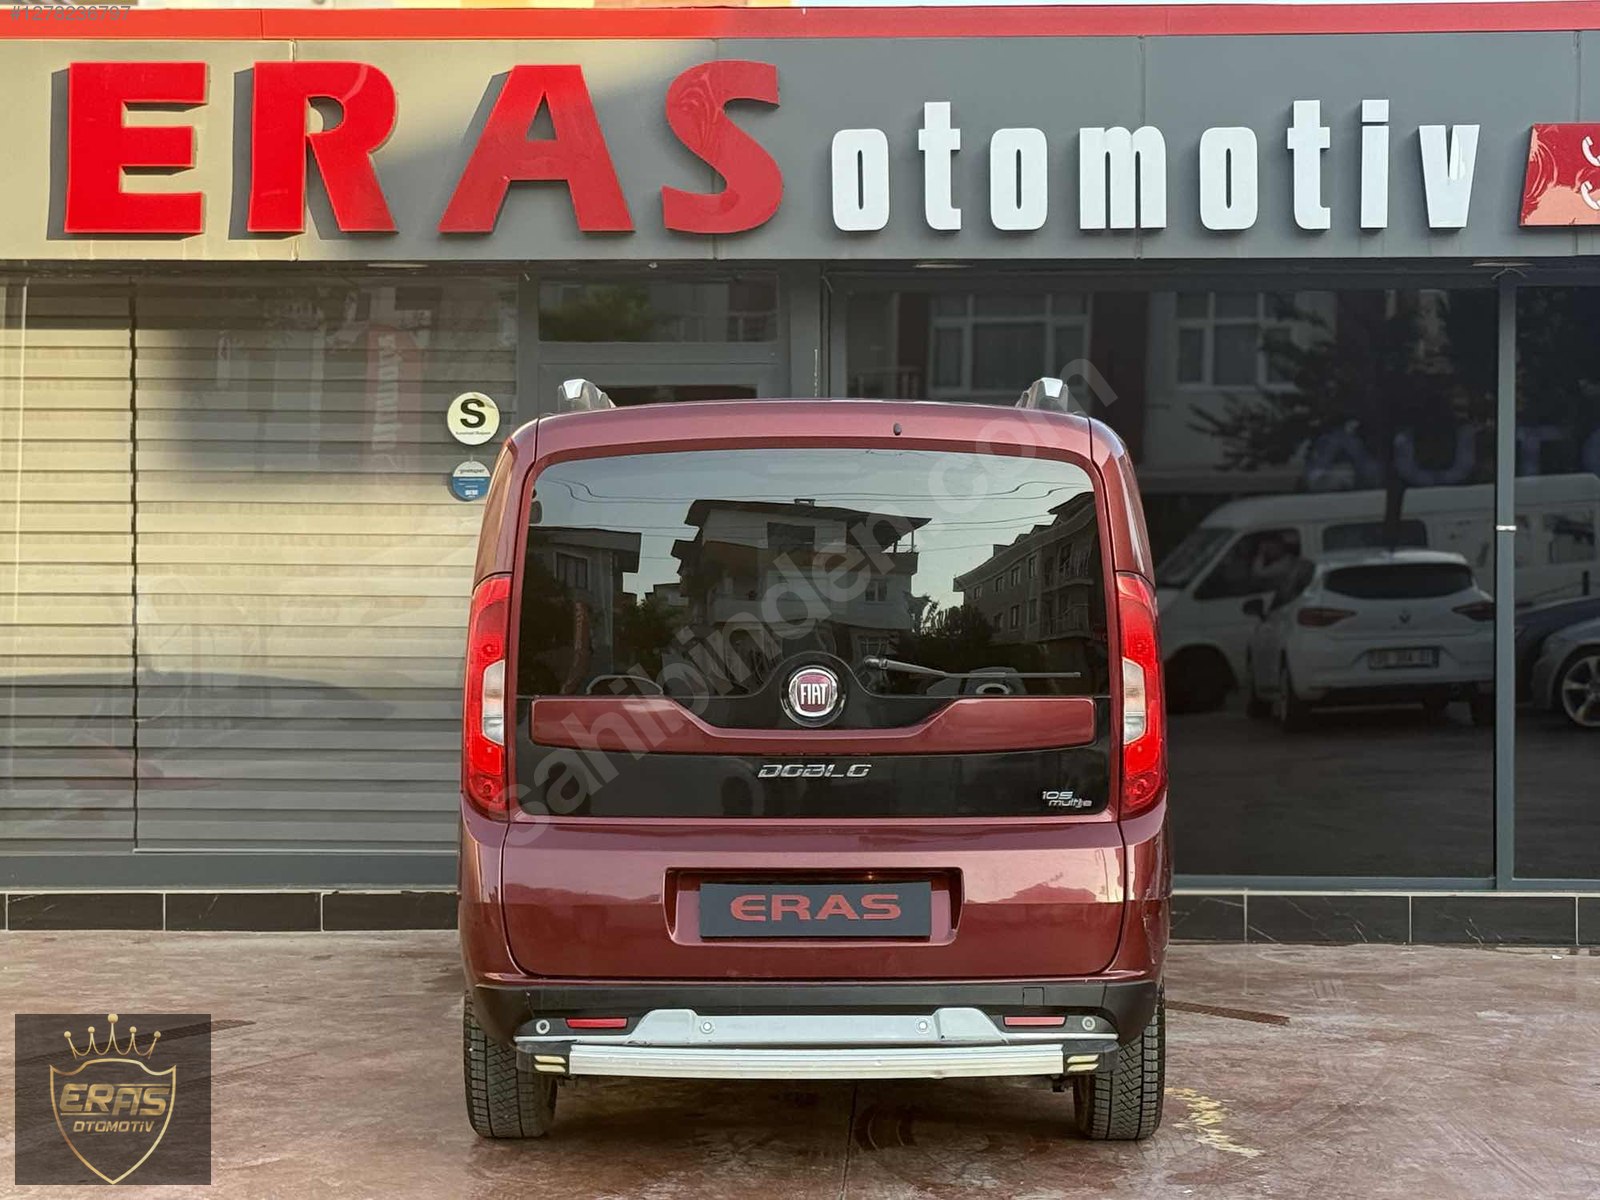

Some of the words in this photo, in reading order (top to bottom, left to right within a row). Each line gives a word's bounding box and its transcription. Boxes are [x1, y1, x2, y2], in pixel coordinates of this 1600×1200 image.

[65, 60, 785, 235] ERAS
[832, 99, 1480, 231] otomotiv
[460, 398, 486, 428] S
[799, 683, 828, 705] FIAT
[730, 894, 902, 921] ERAS
